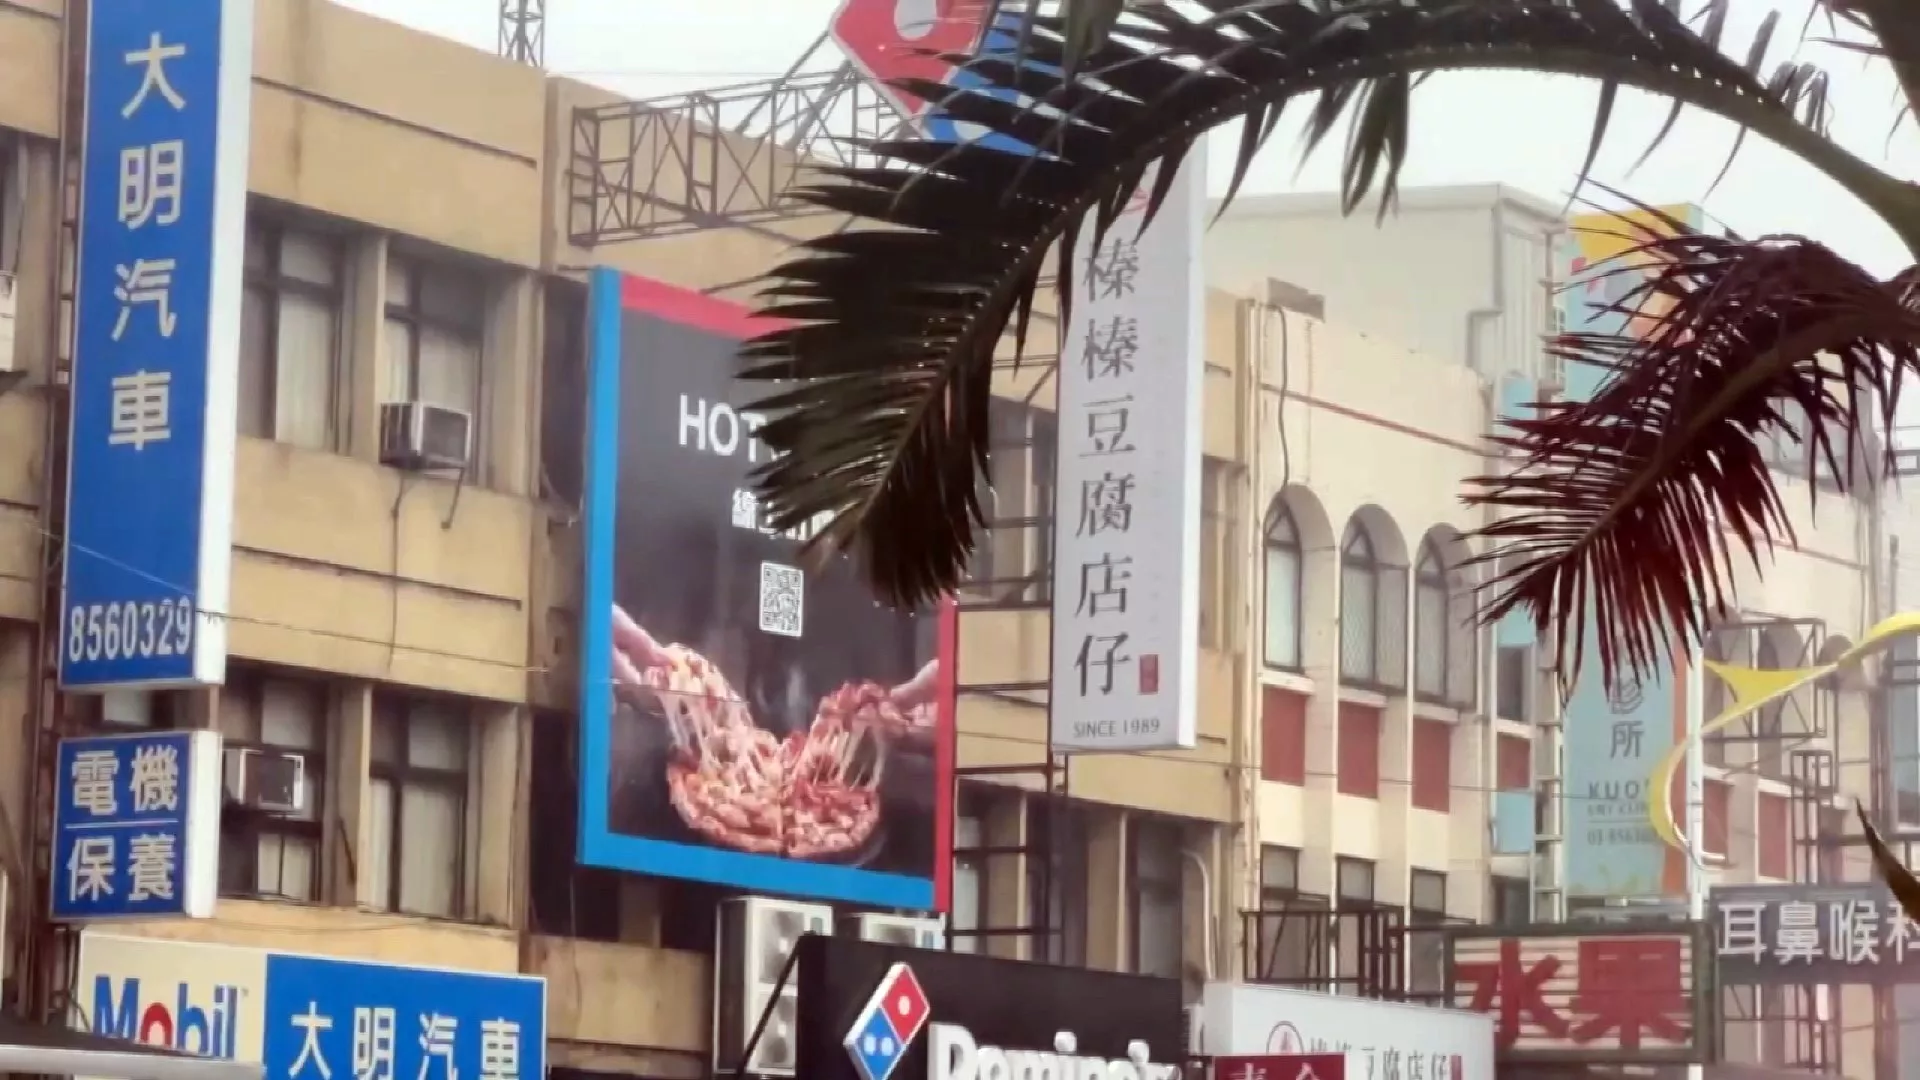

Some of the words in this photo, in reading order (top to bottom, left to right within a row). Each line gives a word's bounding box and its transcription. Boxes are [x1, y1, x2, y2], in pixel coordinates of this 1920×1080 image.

[109, 32, 186, 452] 大明汽車
[69, 595, 191, 662] 8560329
[1073, 719, 1117, 738] SINCE
[1123, 718, 1160, 735] 1989
[72, 745, 178, 816] 電機
[66, 833, 176, 902] 保養
[94, 974, 238, 1059] Mobil
[1454, 938, 1692, 1050] 水果
[288, 1001, 521, 1080] 大明汽車
[928, 1022, 1182, 1080] Domi'
